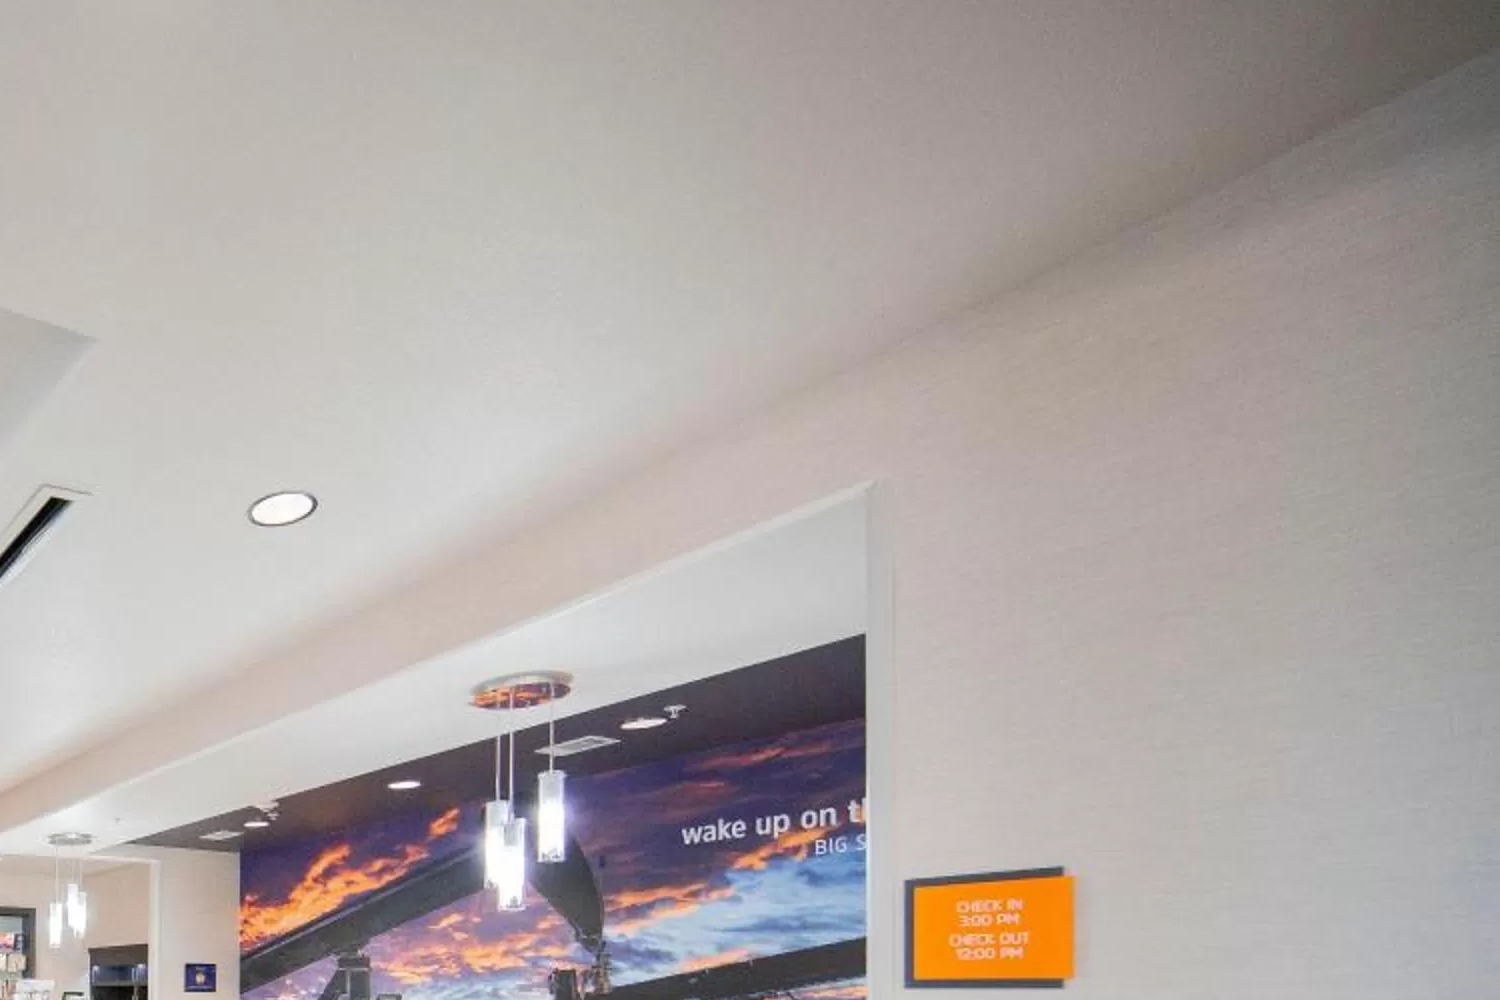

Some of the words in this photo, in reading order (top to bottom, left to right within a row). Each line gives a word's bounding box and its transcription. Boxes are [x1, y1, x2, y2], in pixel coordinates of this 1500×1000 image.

[681, 817, 747, 845] wake
[755, 813, 791, 839] up
[801, 806, 837, 829] on
[815, 836, 847, 855] BIG
[955, 899, 1003, 913] CHECK
[1007, 898, 1024, 911] IN
[958, 914, 992, 927] 3:00
[996, 912, 1021, 925] PM
[949, 932, 996, 947] CHECK
[999, 931, 1029, 945] OUT
[956, 947, 995, 960] 12:00
[999, 946, 1024, 960] PM
